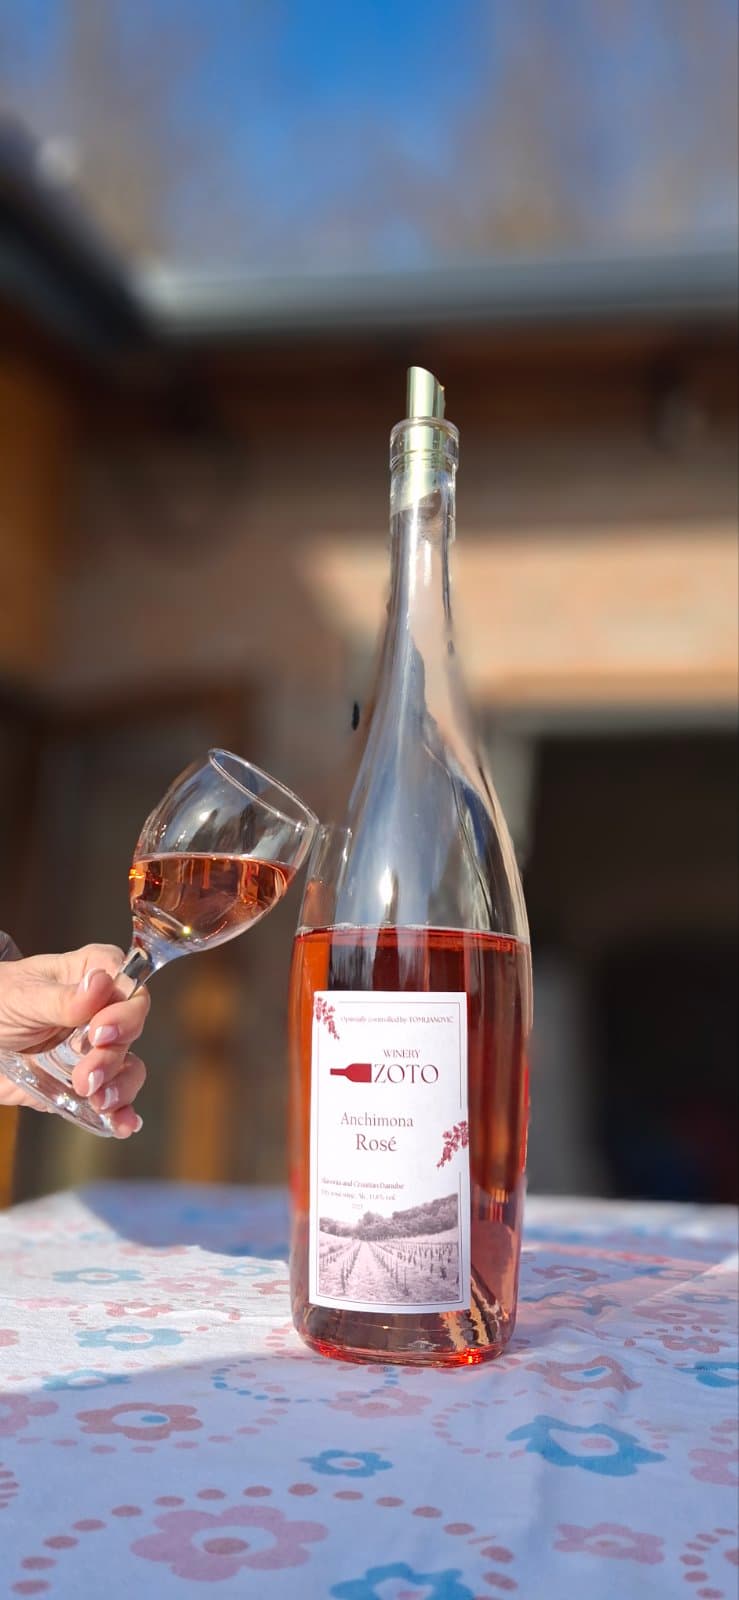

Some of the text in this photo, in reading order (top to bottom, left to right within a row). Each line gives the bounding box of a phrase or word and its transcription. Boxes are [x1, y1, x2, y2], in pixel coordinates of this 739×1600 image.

[383, 1048, 421, 1059] WINERY
[374, 1063, 439, 1084] ZOTO
[340, 1111, 414, 1128] Anchimona
[356, 1133, 398, 1152] Rosé
